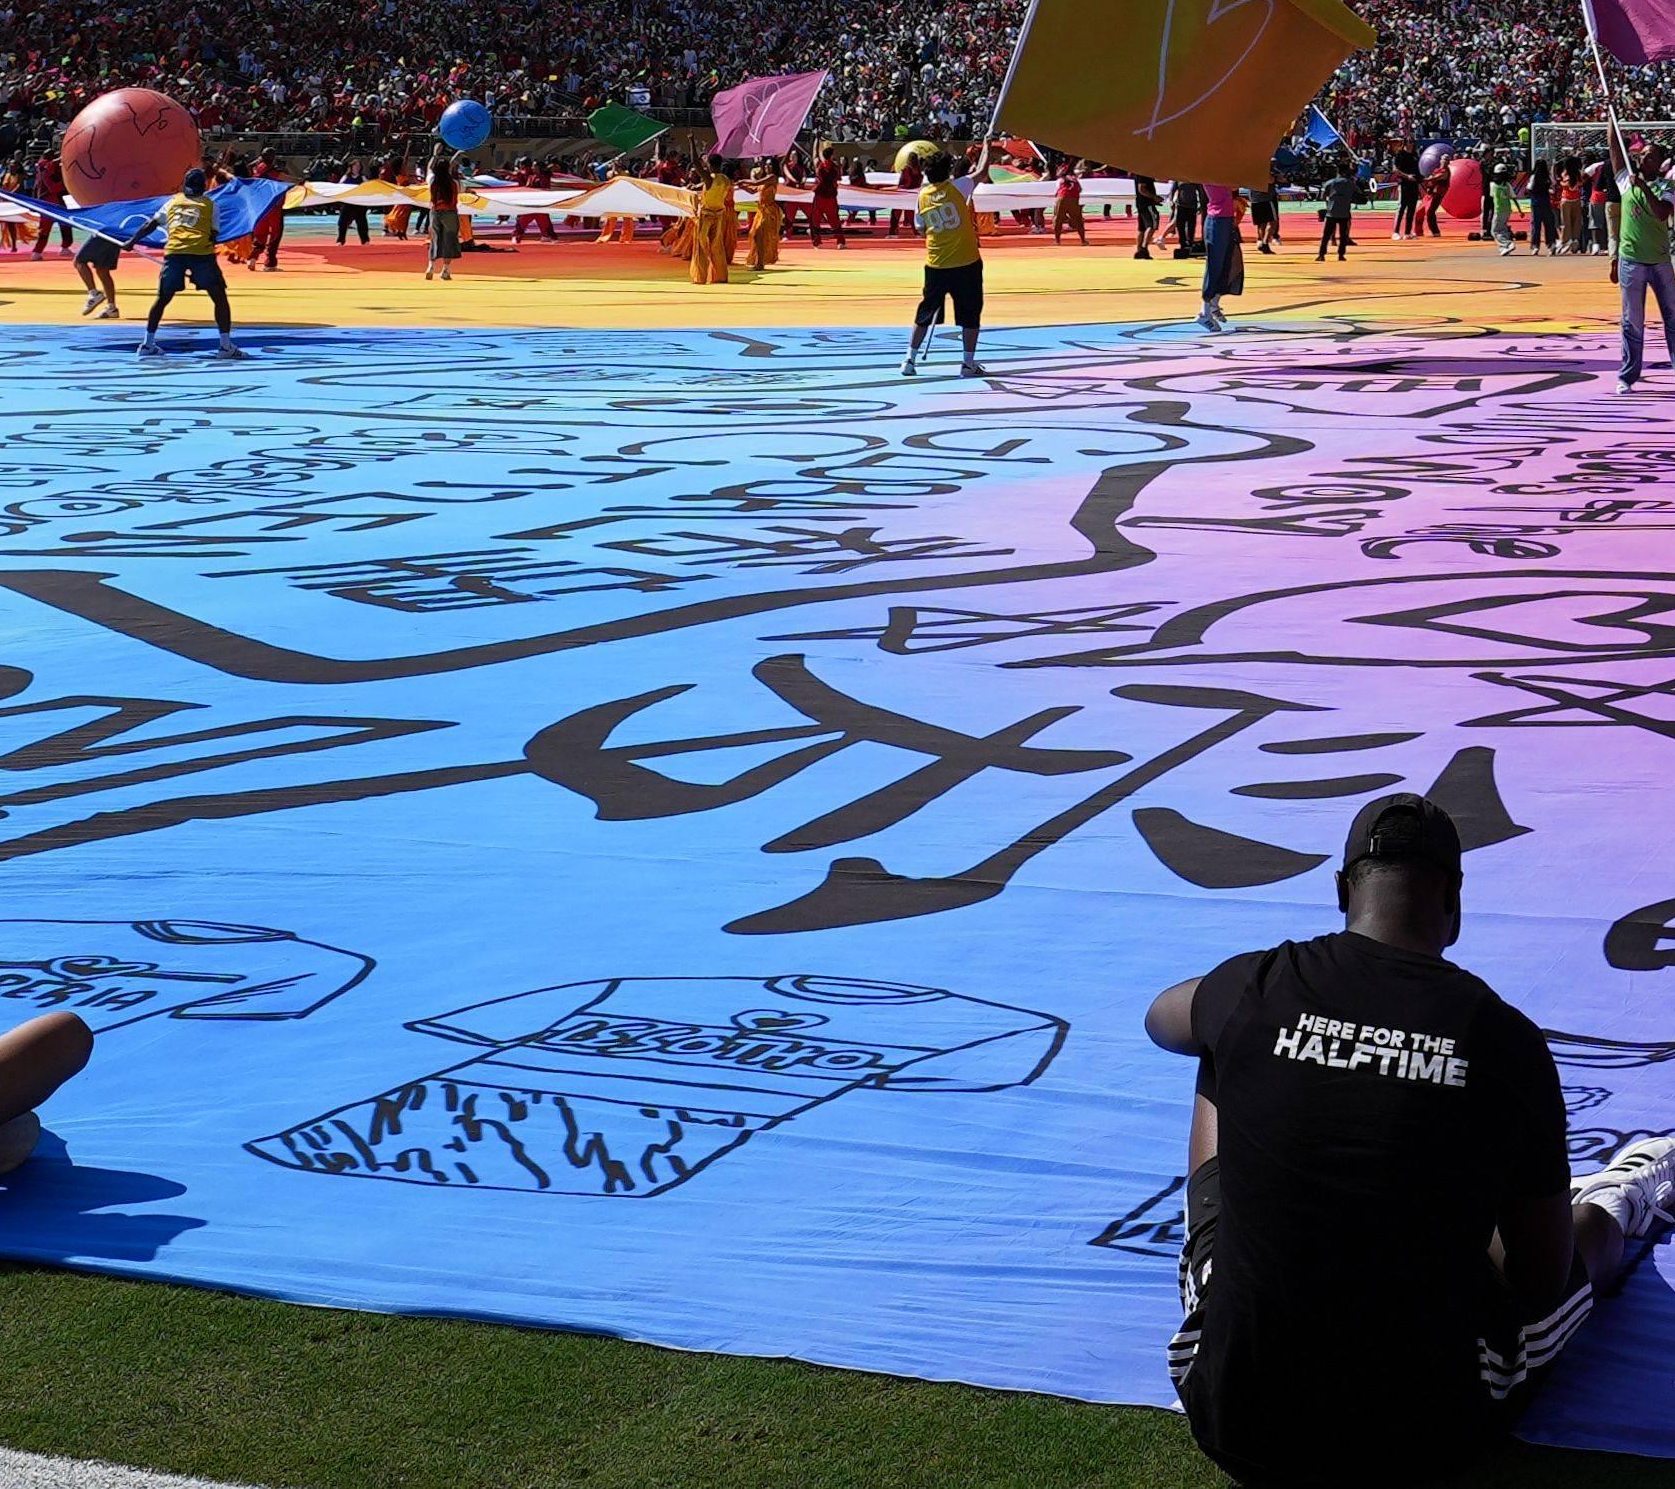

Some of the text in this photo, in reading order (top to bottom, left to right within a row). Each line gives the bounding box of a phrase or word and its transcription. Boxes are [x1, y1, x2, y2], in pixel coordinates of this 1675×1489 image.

[1274, 1028, 1468, 1087] HALFTIME
[1297, 1013, 1455, 1055] HERE FOR THE
